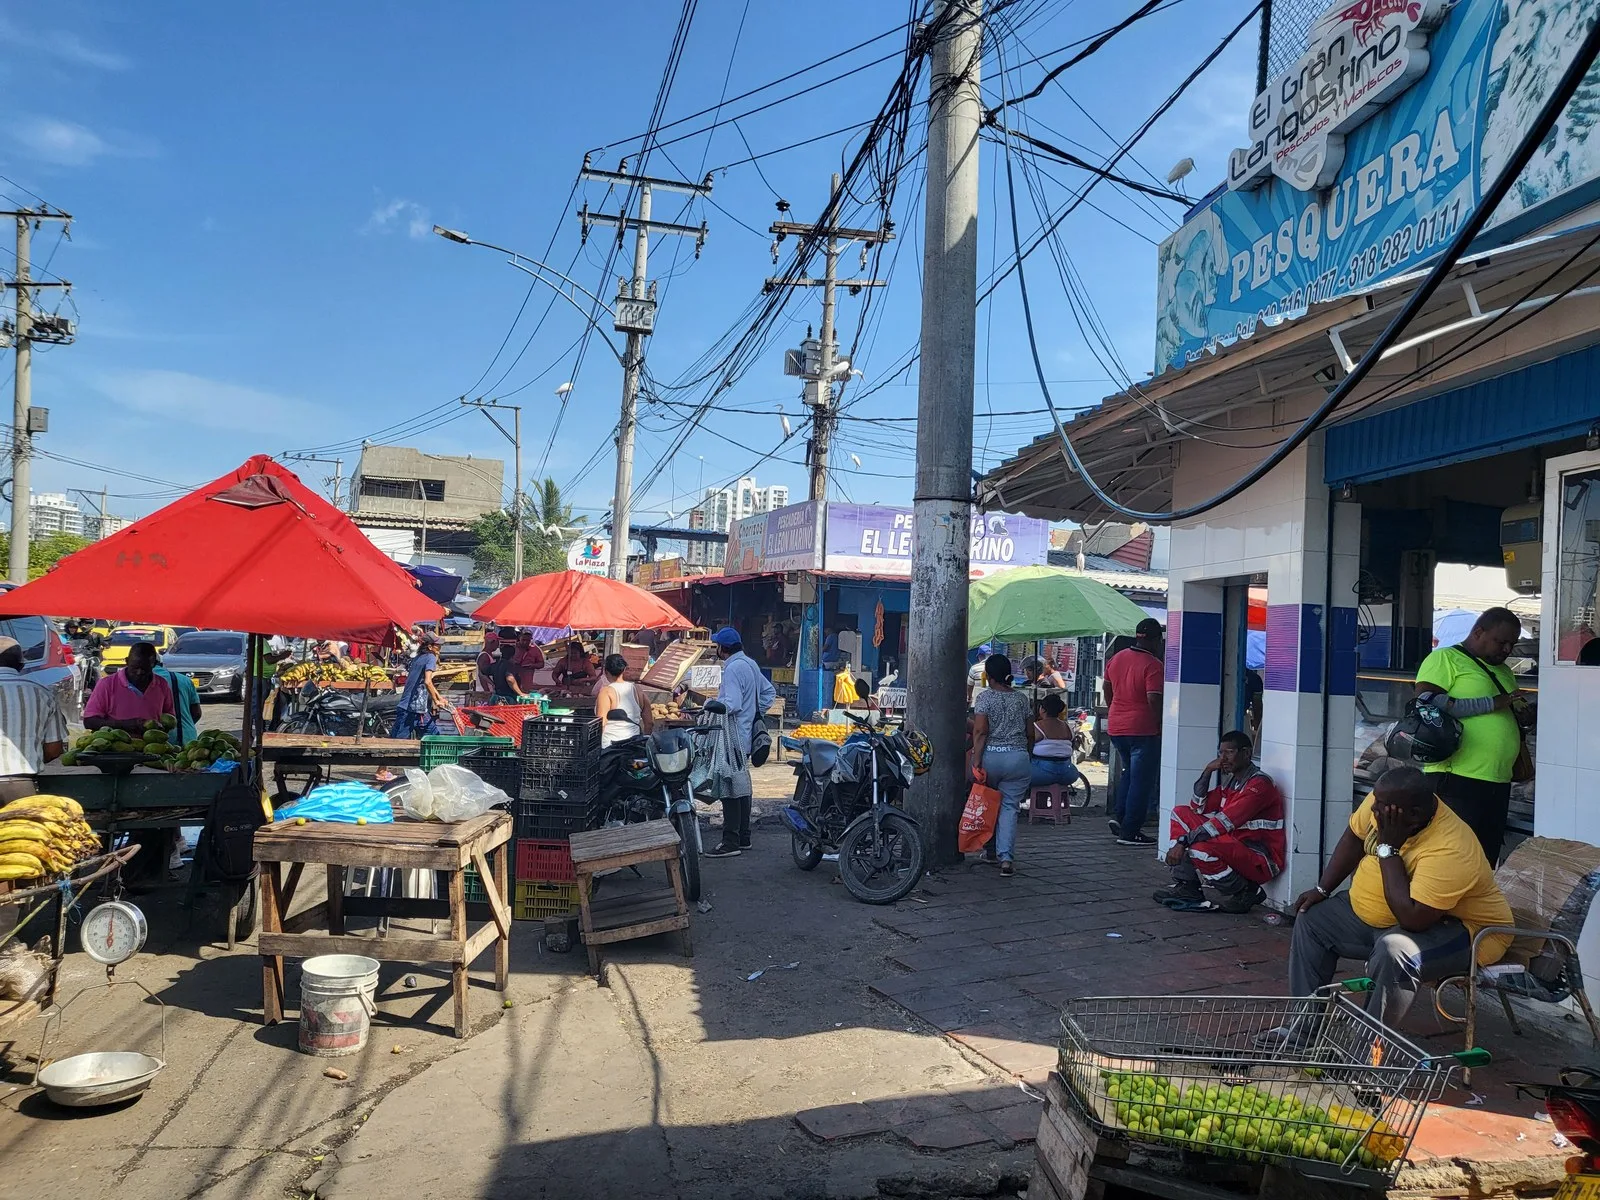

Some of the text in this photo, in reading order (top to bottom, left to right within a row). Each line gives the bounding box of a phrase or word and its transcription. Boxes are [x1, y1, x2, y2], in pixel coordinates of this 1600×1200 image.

[1231, 24, 1402, 181] Langostino
[1252, 34, 1345, 130] El Gran
[1275, 115, 1331, 163] Pescados
[1229, 109, 1460, 302] PESQUERA
[1349, 245, 1377, 289] 318
[1380, 225, 1413, 270] 282
[1415, 197, 1463, 251] 0111
[575, 558, 606, 567] La Plaza
[860, 529, 1015, 562] EL LE RINO
